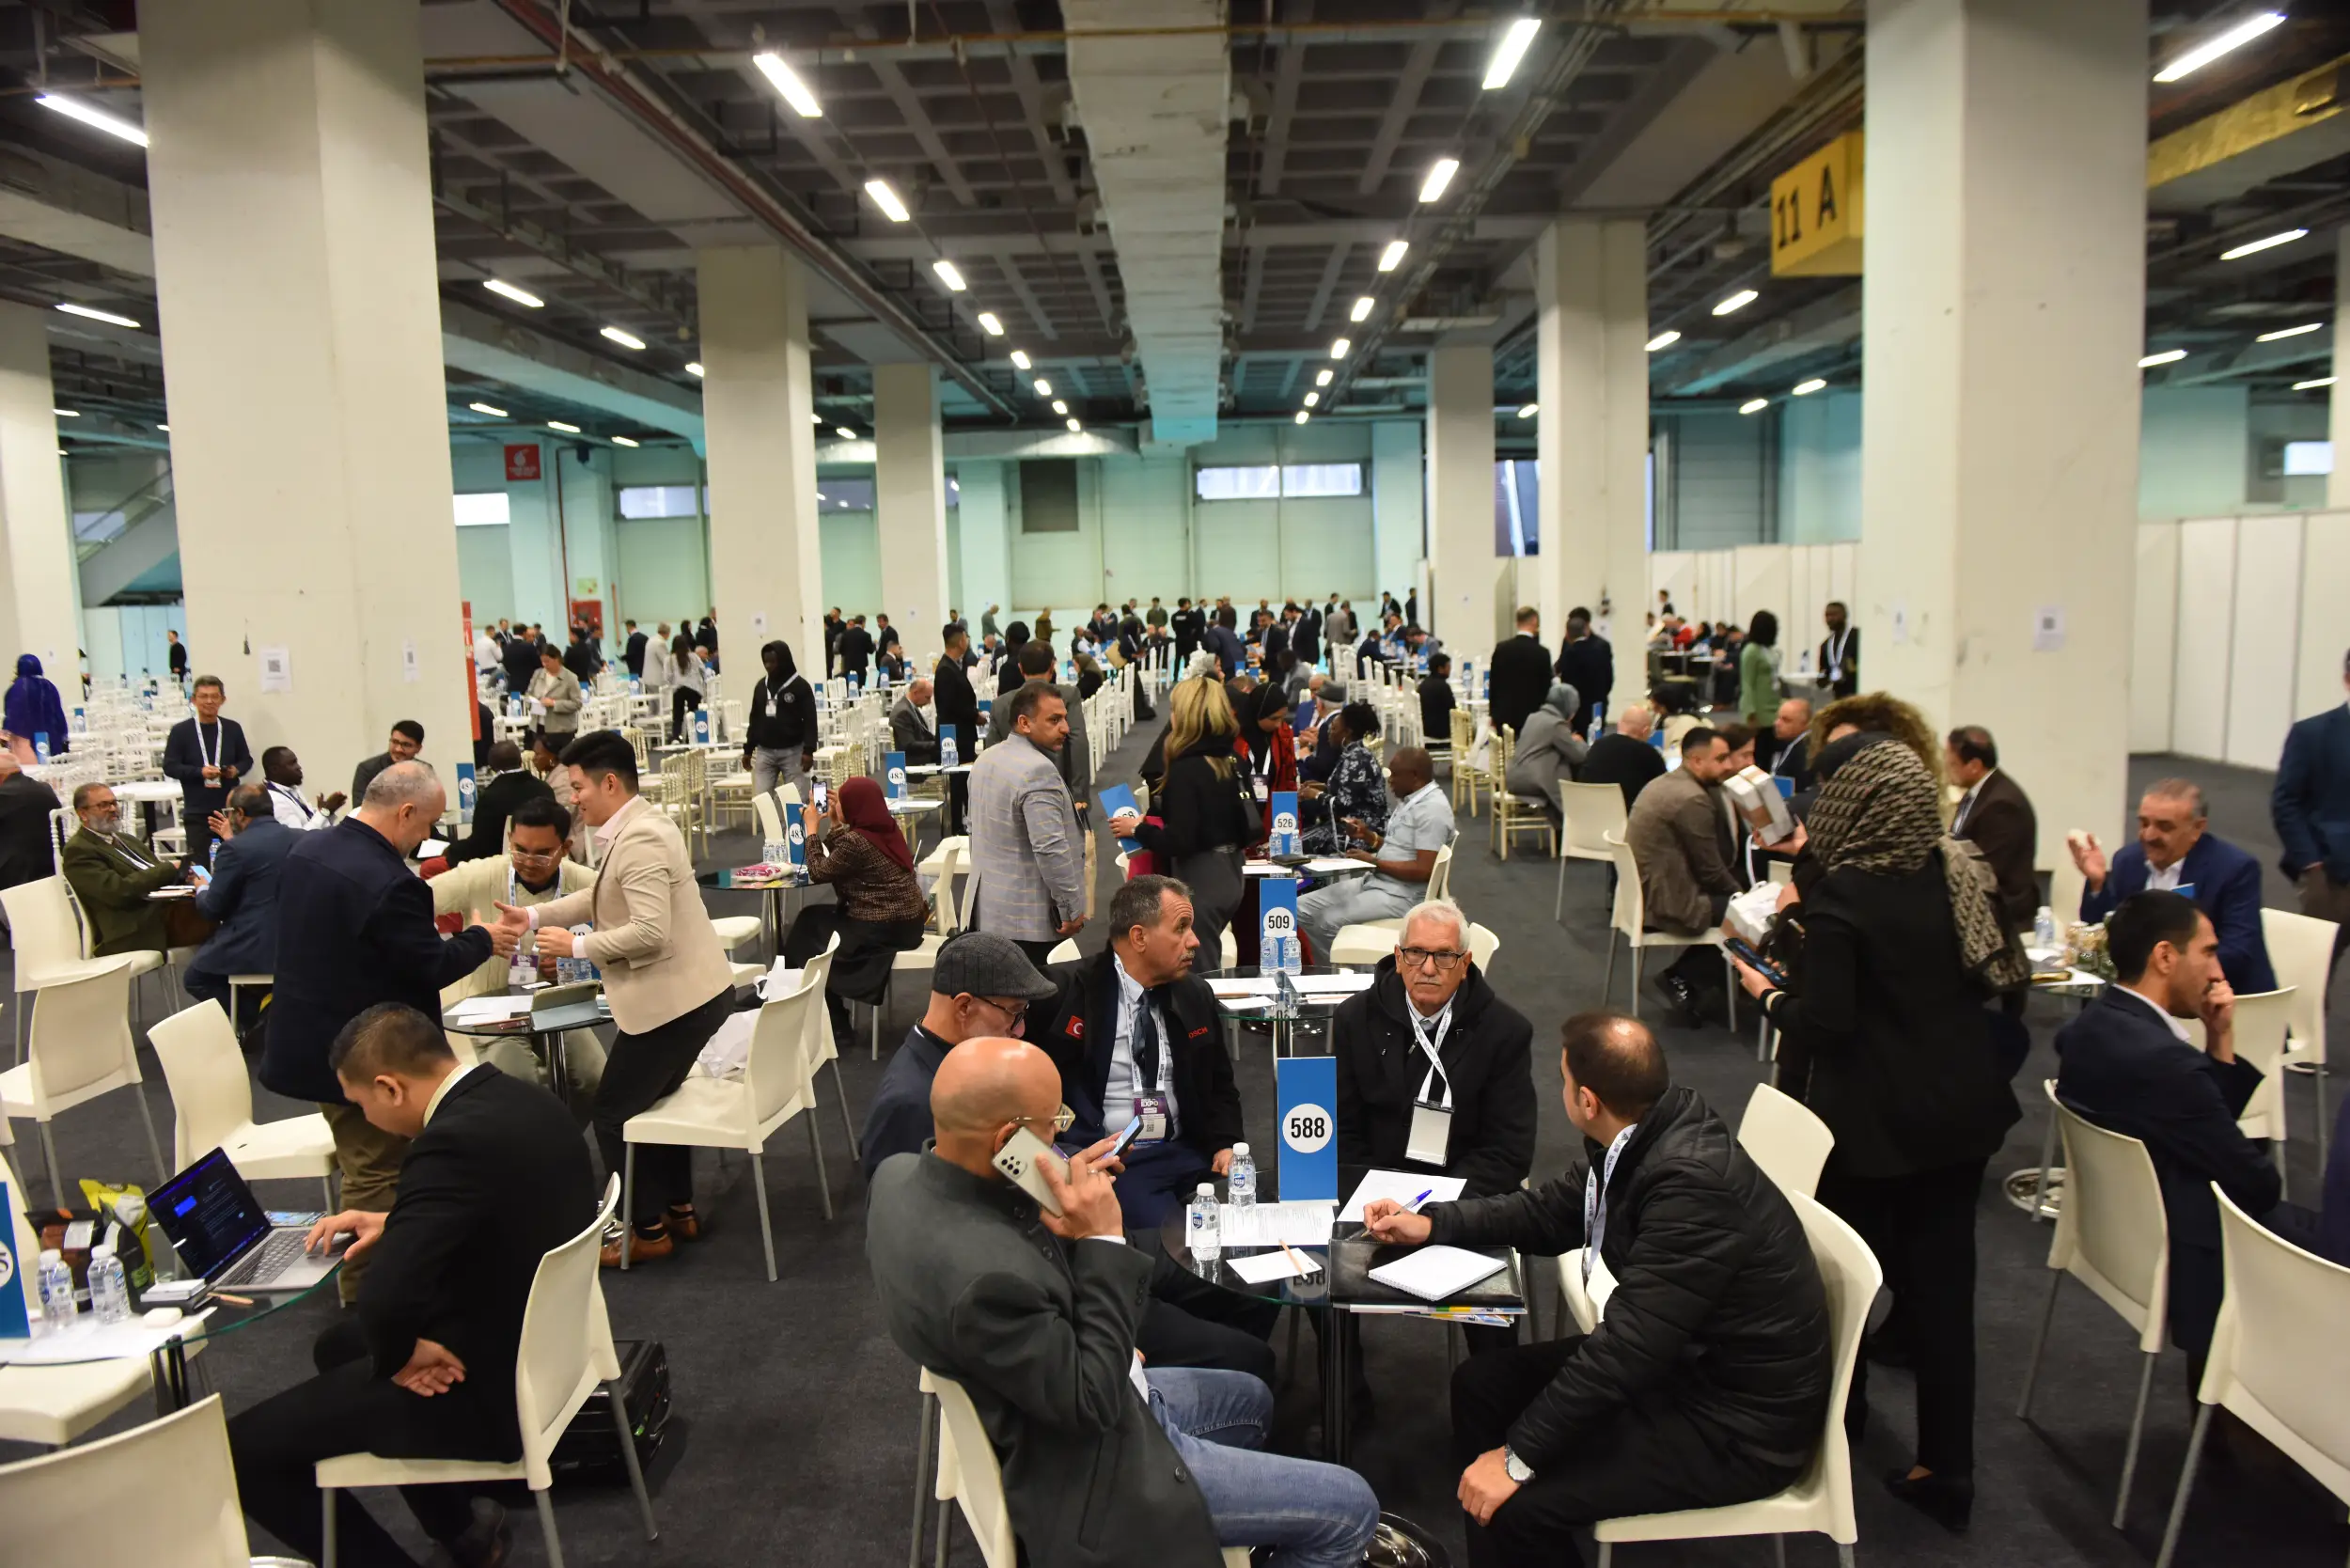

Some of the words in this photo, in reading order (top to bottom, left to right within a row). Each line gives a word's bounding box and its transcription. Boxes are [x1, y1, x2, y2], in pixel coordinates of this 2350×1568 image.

[1776, 185, 1802, 251] 11
[1817, 163, 1838, 230] A
[1277, 818, 1293, 828] 526
[1268, 915, 1290, 929] 509
[1188, 1026, 1208, 1039] OSCH
[1291, 1117, 1325, 1138] 588
